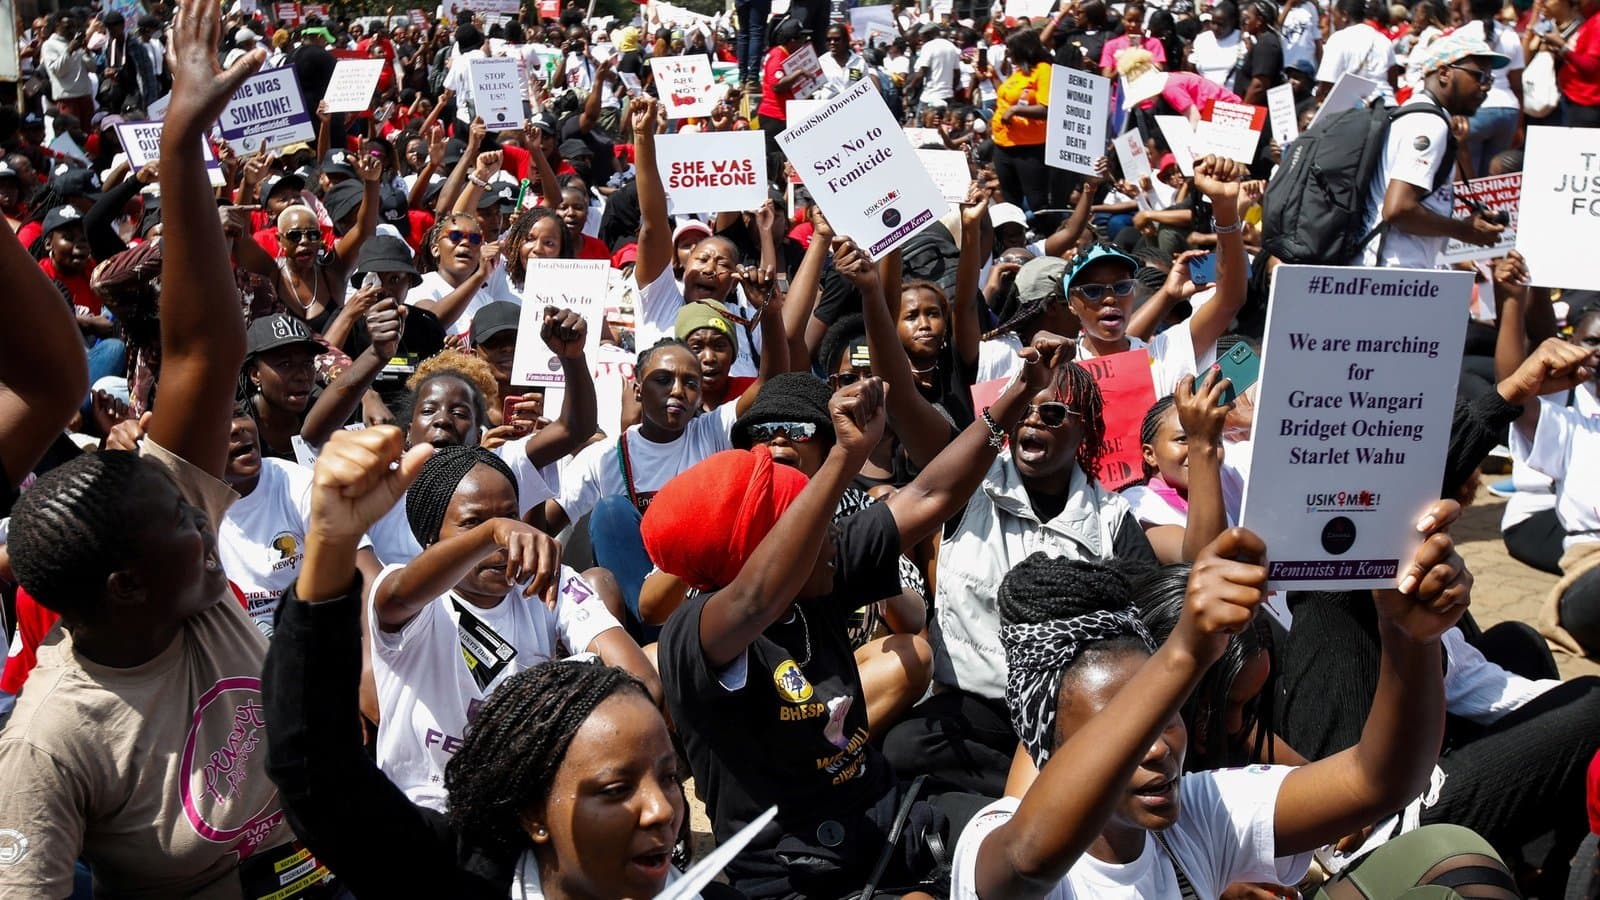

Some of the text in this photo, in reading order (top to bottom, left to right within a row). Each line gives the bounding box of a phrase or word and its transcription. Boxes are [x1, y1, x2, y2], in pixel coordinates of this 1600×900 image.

[484, 72, 506, 80] STOP
[673, 65, 689, 73] WE
[253, 78, 281, 96] was
[479, 82, 514, 91] KILLING
[1068, 74, 1094, 89] BEING A
[1066, 89, 1093, 105] WOMAN
[230, 96, 292, 125] SOMEONE!
[783, 82, 872, 144] #TotalShutDownKE
[1065, 104, 1091, 120] SHOULD
[134, 127, 162, 139] PRO
[1062, 119, 1092, 135] NOT BE A
[1065, 135, 1087, 150] DEATH
[813, 127, 882, 176] Say No to
[1059, 149, 1091, 166] SENTENCE
[671, 159, 753, 175] SHE WAS
[827, 146, 894, 194] Femicide
[669, 172, 756, 188] SOMEONE
[870, 210, 932, 255] Feminists in Kenya
[1308, 275, 1440, 298] #EndFemicide
[535, 293, 593, 305] Say No to
[1288, 332, 1440, 359] We are marching
[1088, 360, 1115, 380] DE
[1347, 363, 1375, 381] for
[1288, 390, 1424, 414] Grace Wangari
[1279, 418, 1425, 442] Bridget Ochieng
[1288, 446, 1406, 465] Starlet Wahu
[1105, 460, 1132, 483] ED
[1271, 561, 1396, 578] Feminists in Kenya
[244, 591, 267, 600] CIDE
[780, 703, 825, 720] BHESP
[425, 727, 466, 756] FE
